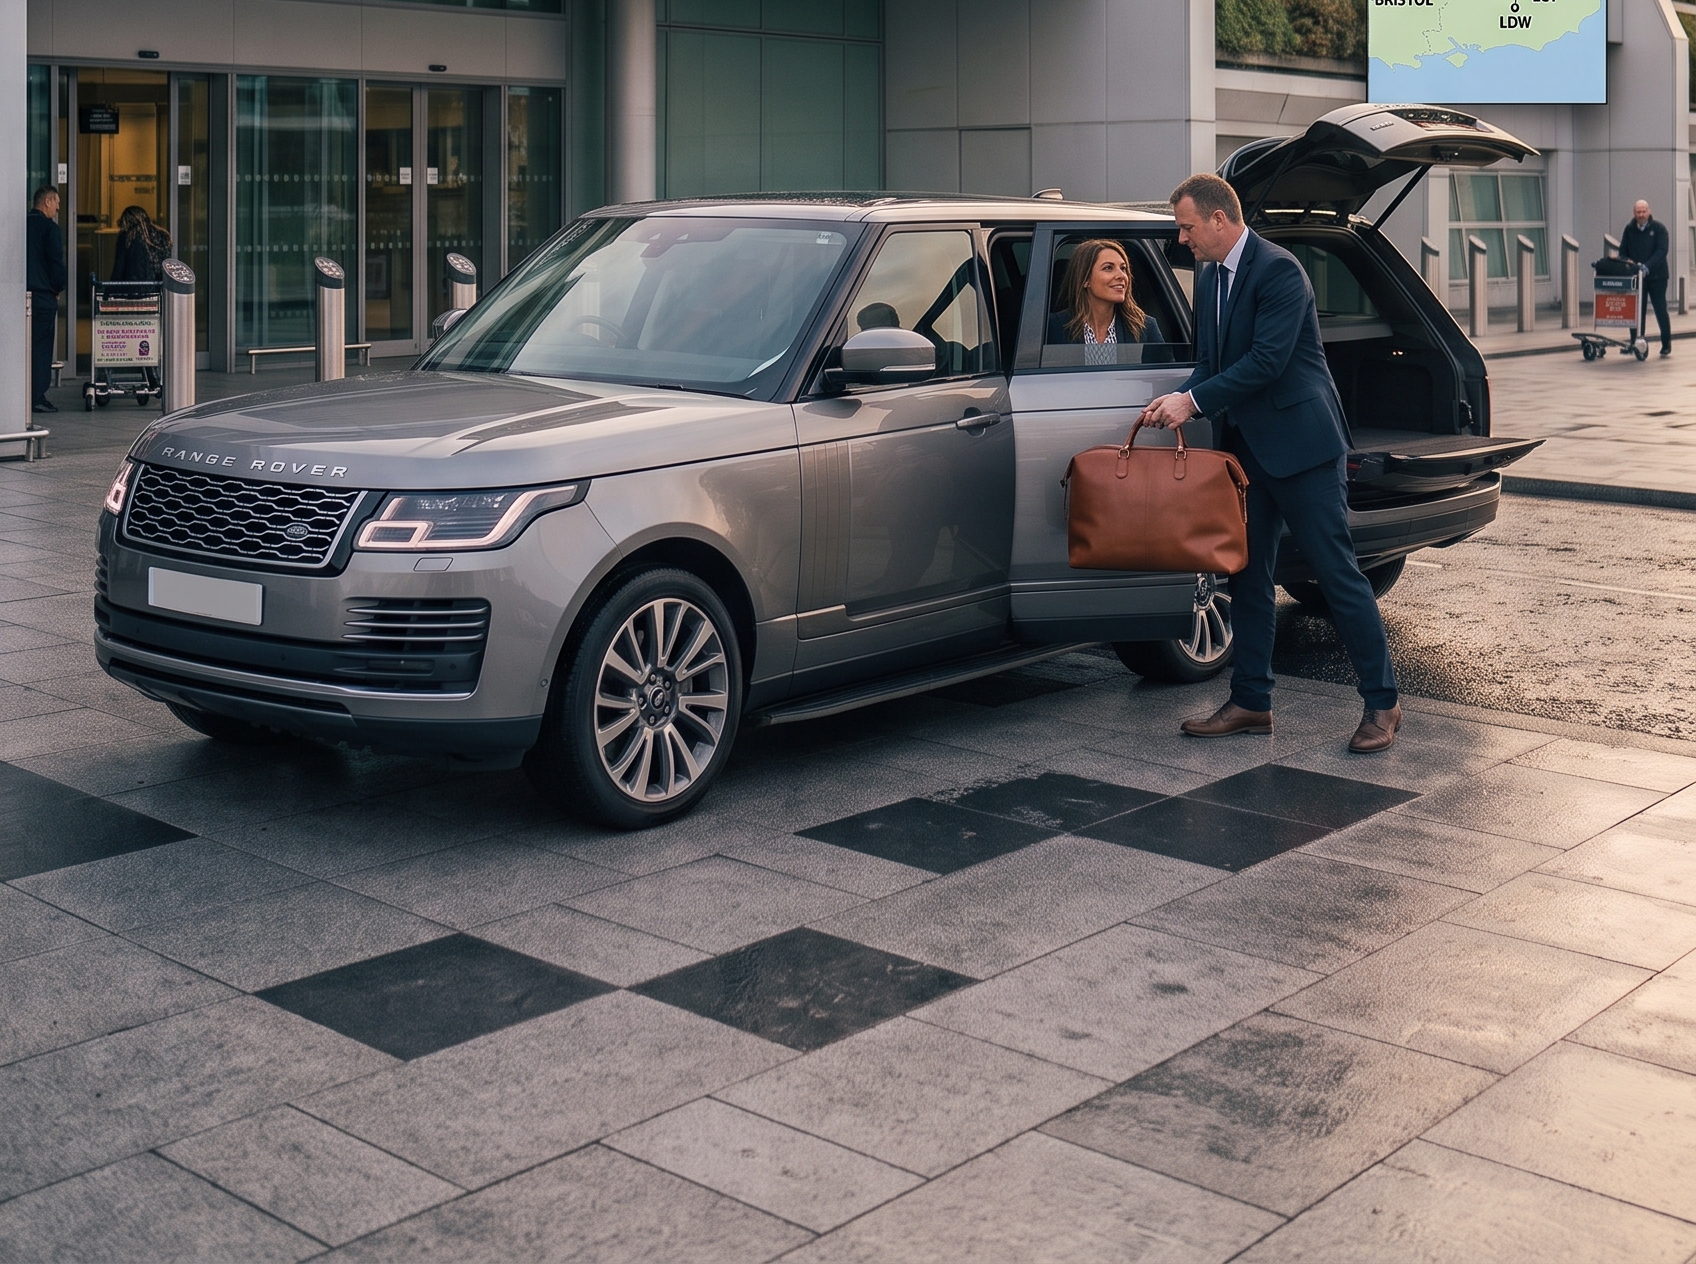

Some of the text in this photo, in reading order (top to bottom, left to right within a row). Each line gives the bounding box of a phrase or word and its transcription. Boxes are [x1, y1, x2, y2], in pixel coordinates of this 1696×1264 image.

[1499, 15, 1532, 29] LDW
[161, 446, 349, 479] RANGE ROVER
